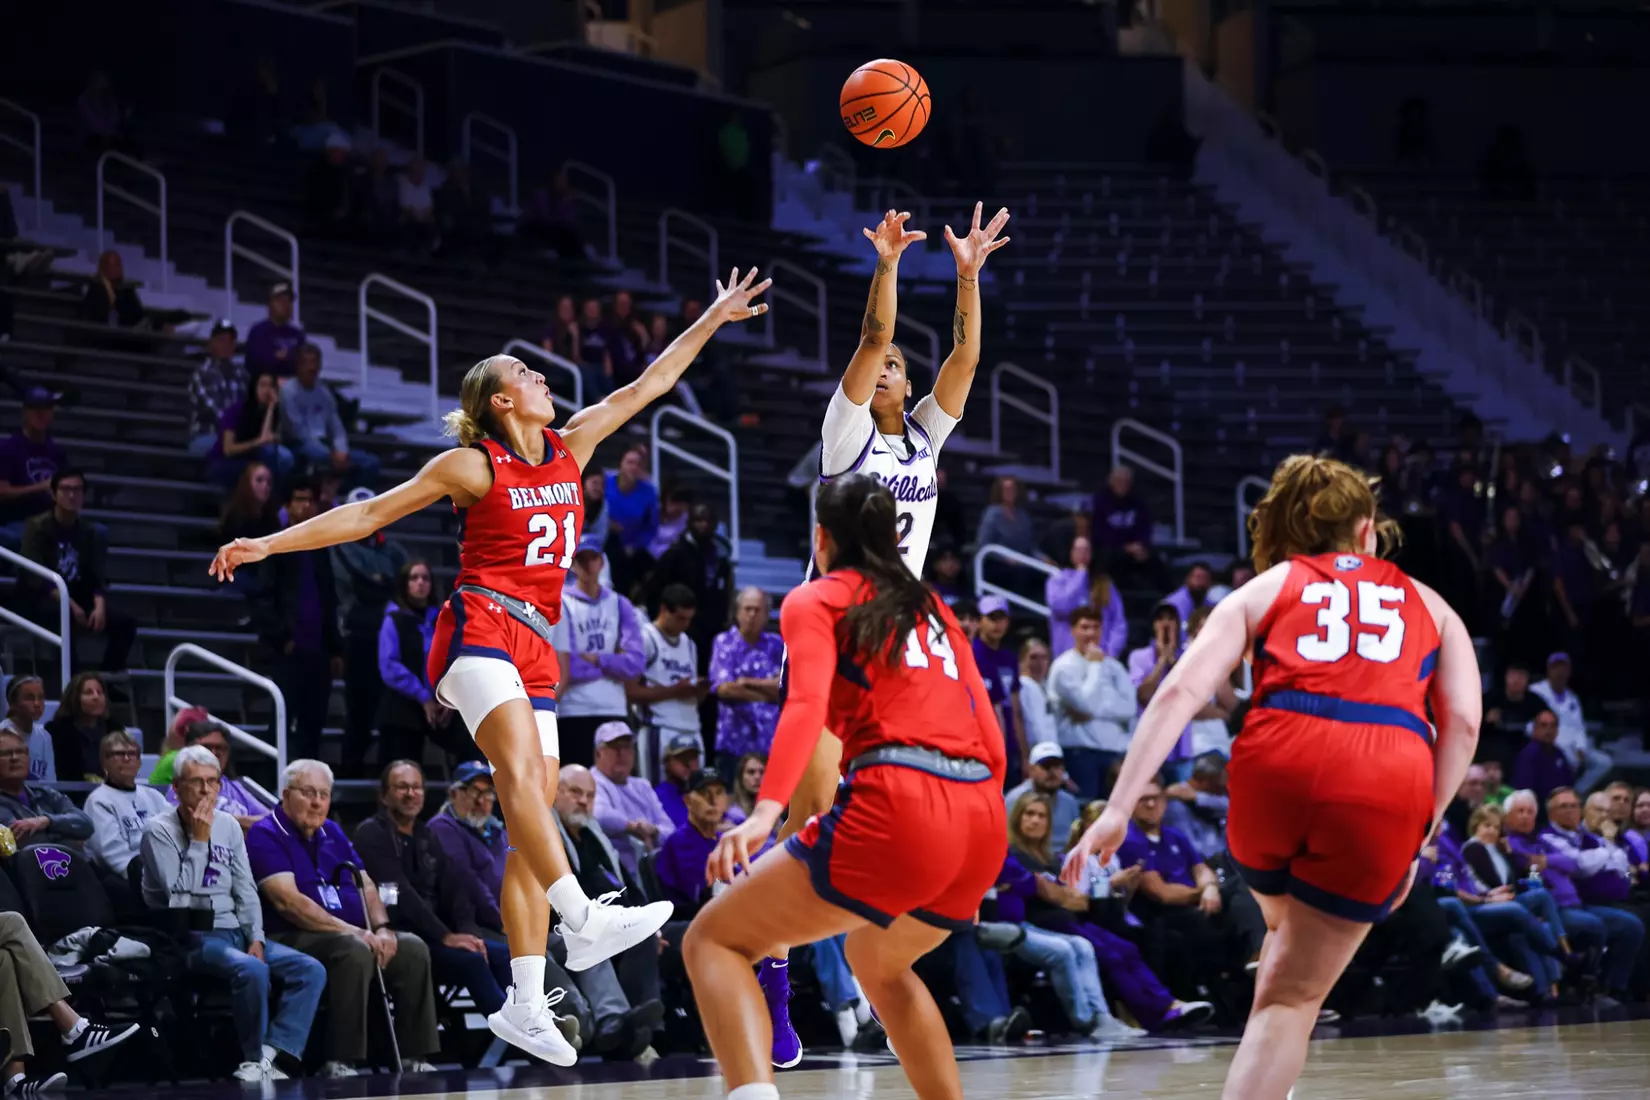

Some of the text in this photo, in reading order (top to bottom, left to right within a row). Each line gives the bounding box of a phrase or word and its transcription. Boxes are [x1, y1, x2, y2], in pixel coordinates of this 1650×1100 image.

[507, 482, 581, 510] BELMONT
[524, 511, 576, 569] 21
[904, 612, 959, 680] 14
[1296, 578, 1406, 664] 35
